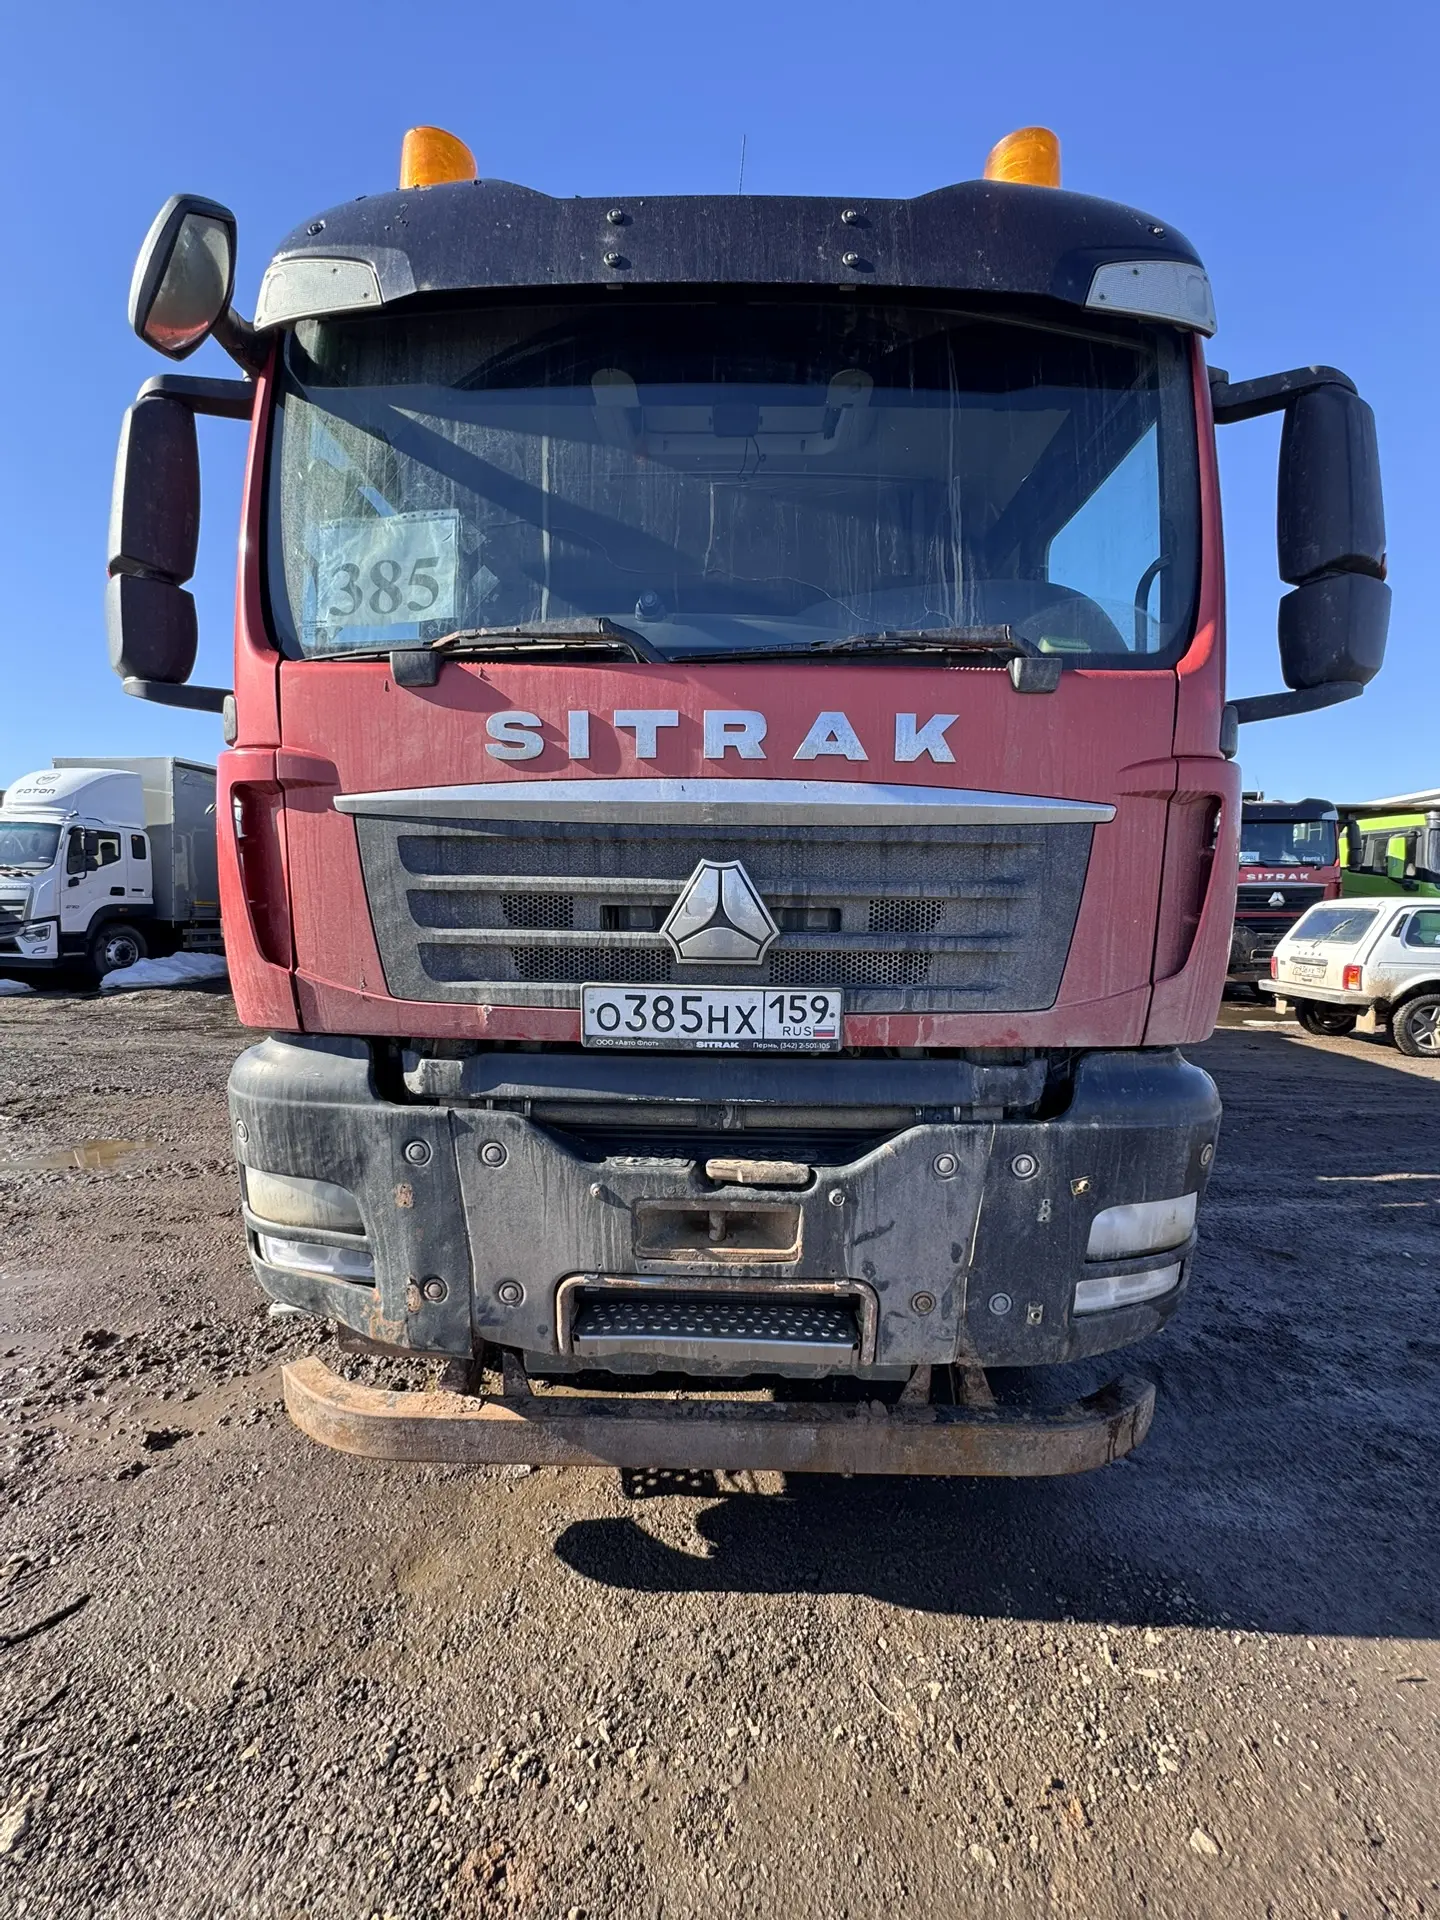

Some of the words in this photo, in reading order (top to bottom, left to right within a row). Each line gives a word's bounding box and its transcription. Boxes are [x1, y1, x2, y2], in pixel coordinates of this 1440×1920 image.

[329, 556, 440, 617] 385
[484, 709, 960, 764] SITRAK
[1246, 873, 1310, 881] SITRAK
[768, 994, 829, 1024] 159
[782, 1026, 812, 1037] RUS
[695, 1041, 740, 1049] SITRAK
[780, 1042, 798, 1050] (342)
